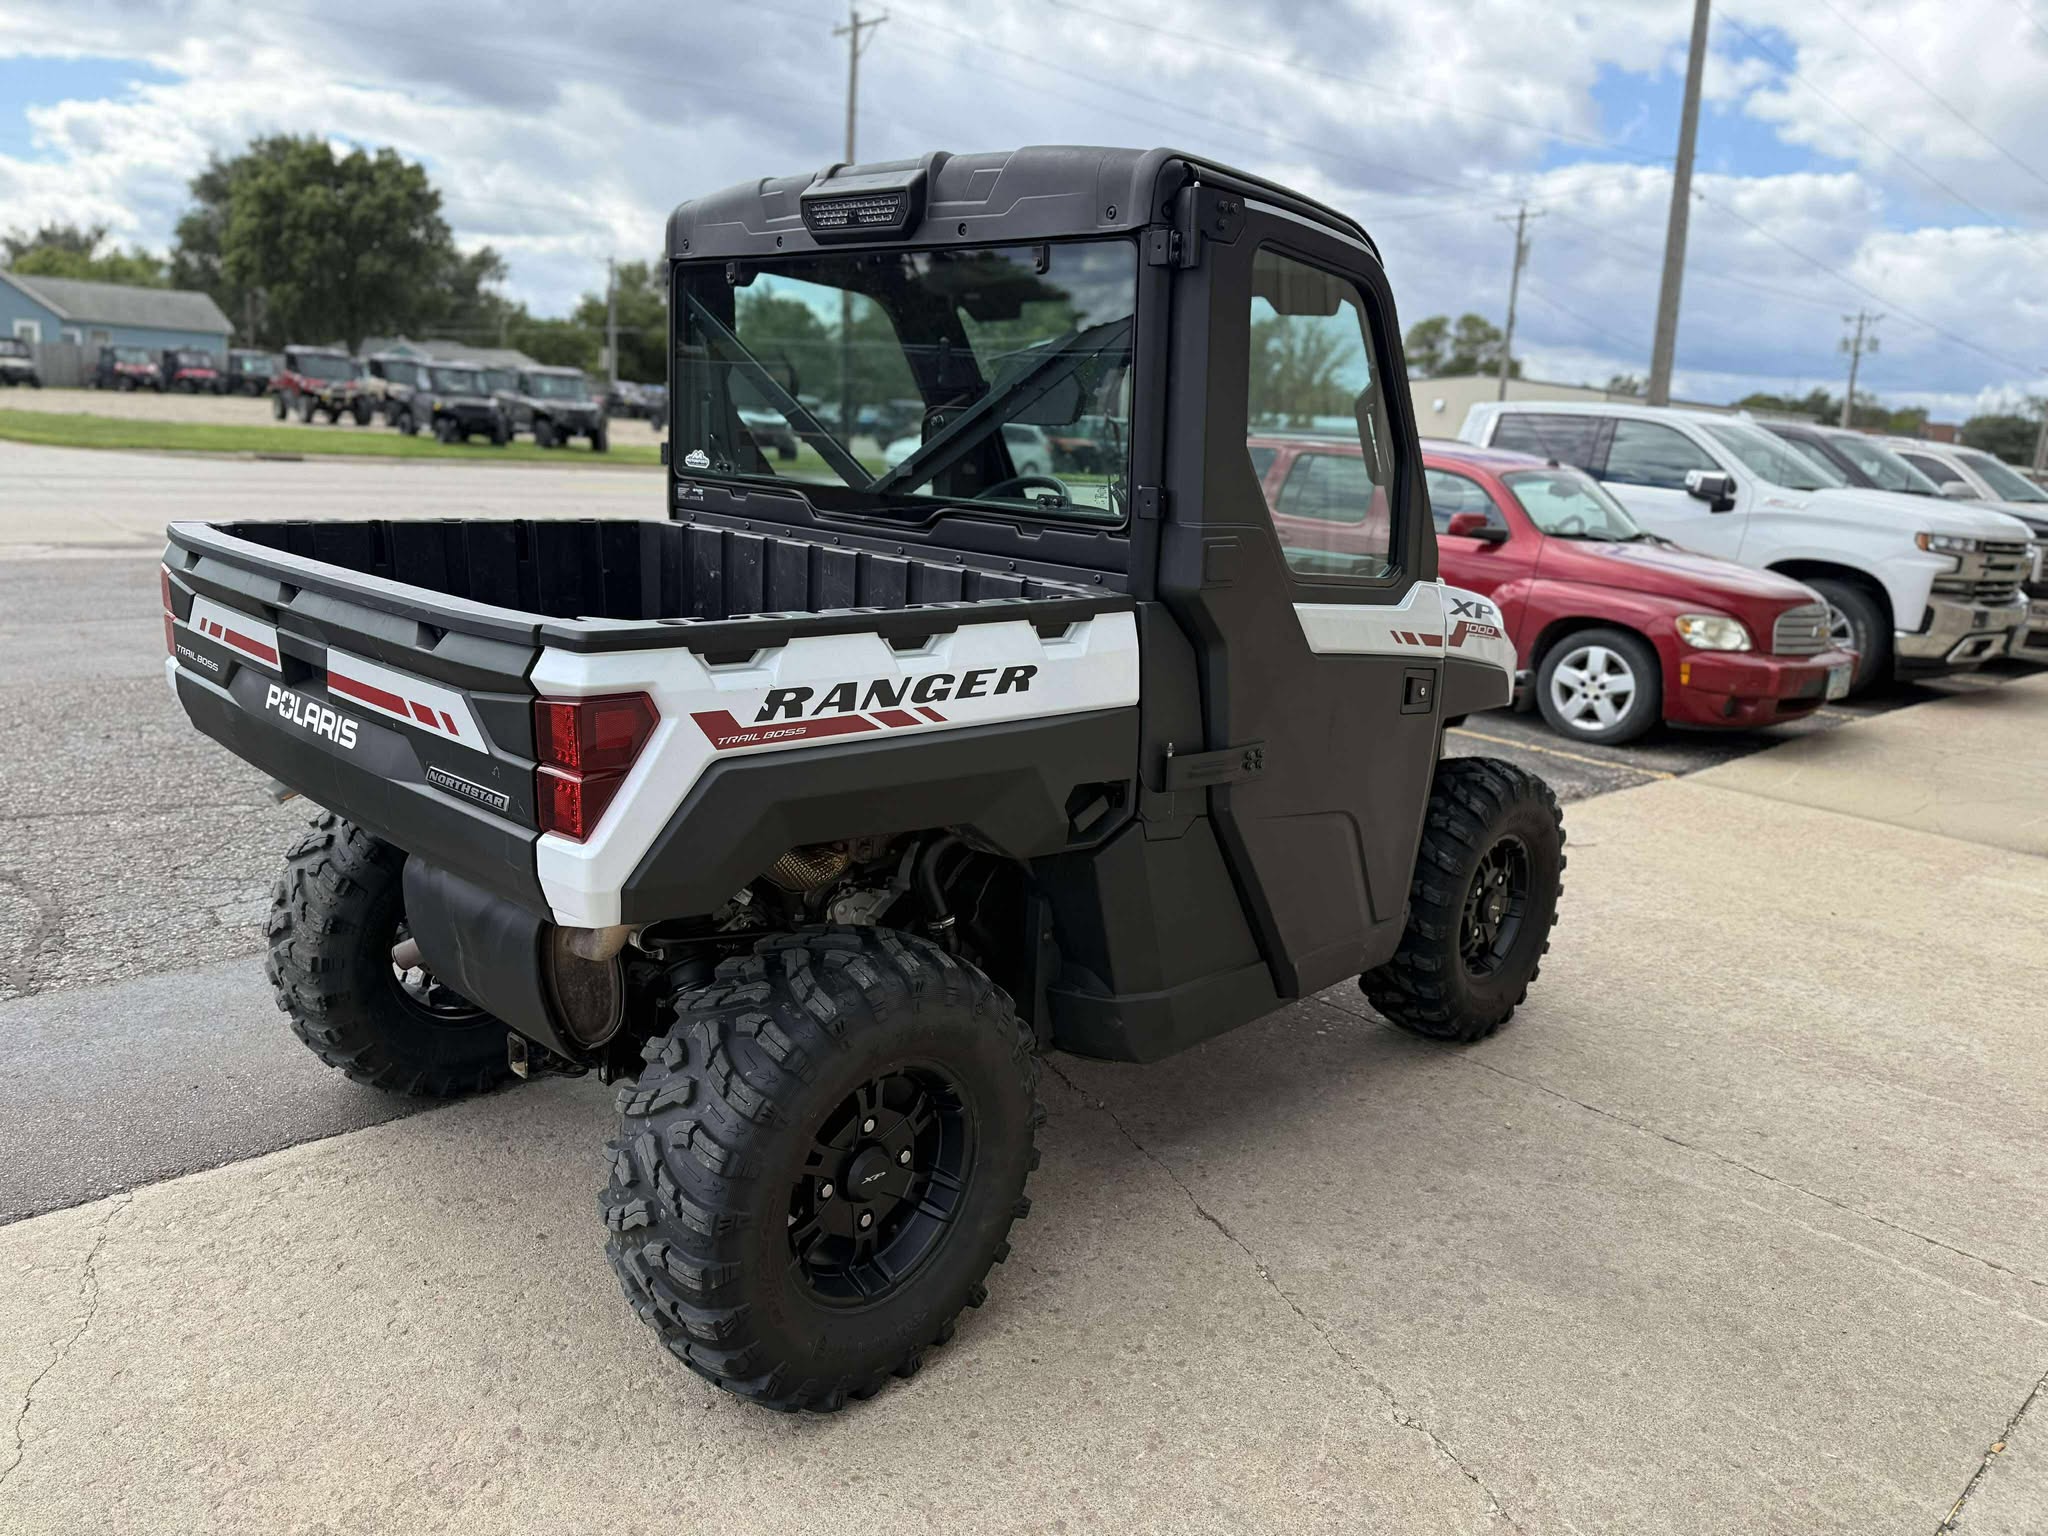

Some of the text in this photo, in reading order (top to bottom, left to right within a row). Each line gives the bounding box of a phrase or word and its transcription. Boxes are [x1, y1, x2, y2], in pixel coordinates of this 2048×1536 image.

[1449, 597, 1494, 619] XP
[1466, 623, 1495, 635] 1000
[176, 643, 219, 672] TRAIL BOSS
[754, 664, 1038, 722] RANGER
[265, 683, 358, 750] POLARIS
[717, 727, 807, 745] TRAIL BOSS
[429, 770, 504, 808] NORTHSTAR
[861, 1171, 886, 1185] XP
